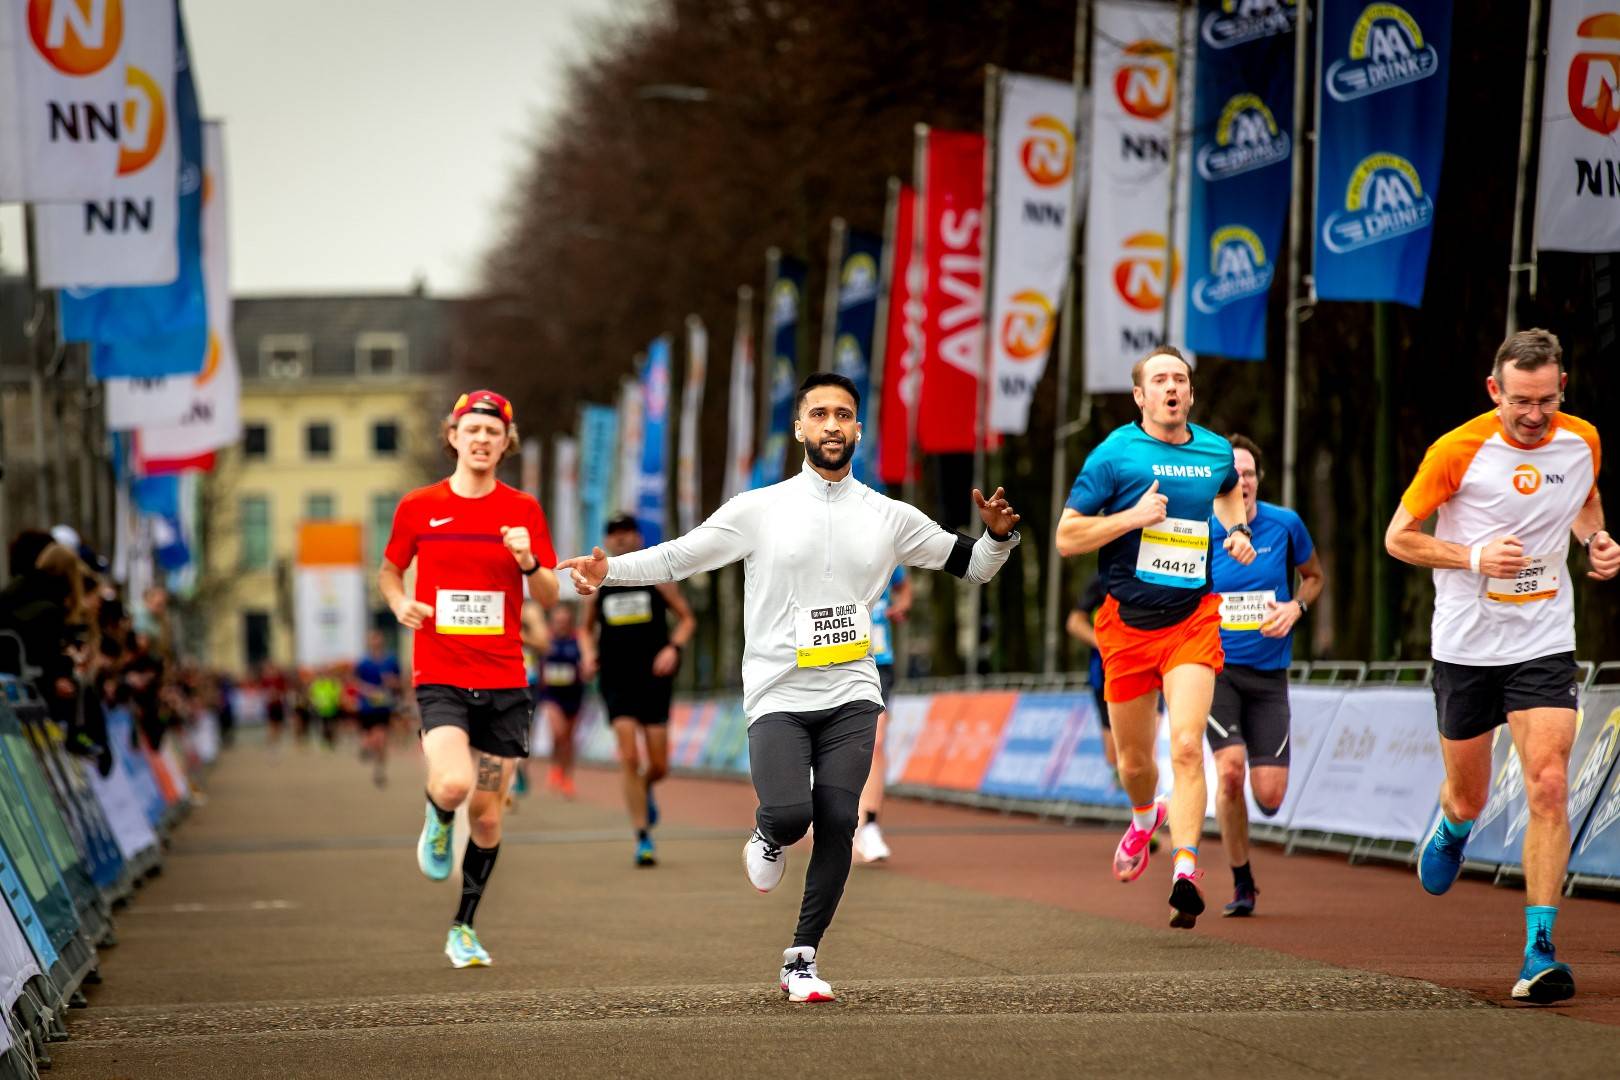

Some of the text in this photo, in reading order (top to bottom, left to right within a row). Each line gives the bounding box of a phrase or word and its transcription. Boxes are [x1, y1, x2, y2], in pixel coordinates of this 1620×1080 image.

[47, 101, 119, 142] NN
[1121, 133, 1169, 163] NN
[84, 198, 153, 235] NN
[938, 207, 986, 378] AVIS
[1152, 464, 1212, 477] SIEMENS
[1546, 475, 1565, 484] NN
[1152, 558, 1196, 574] 44412
[1518, 566, 1546, 579] ERRY
[1514, 580, 1538, 593] 339
[454, 604, 487, 613] JELLE
[815, 616, 854, 631] RAOEL
[813, 630, 857, 645] 21890
